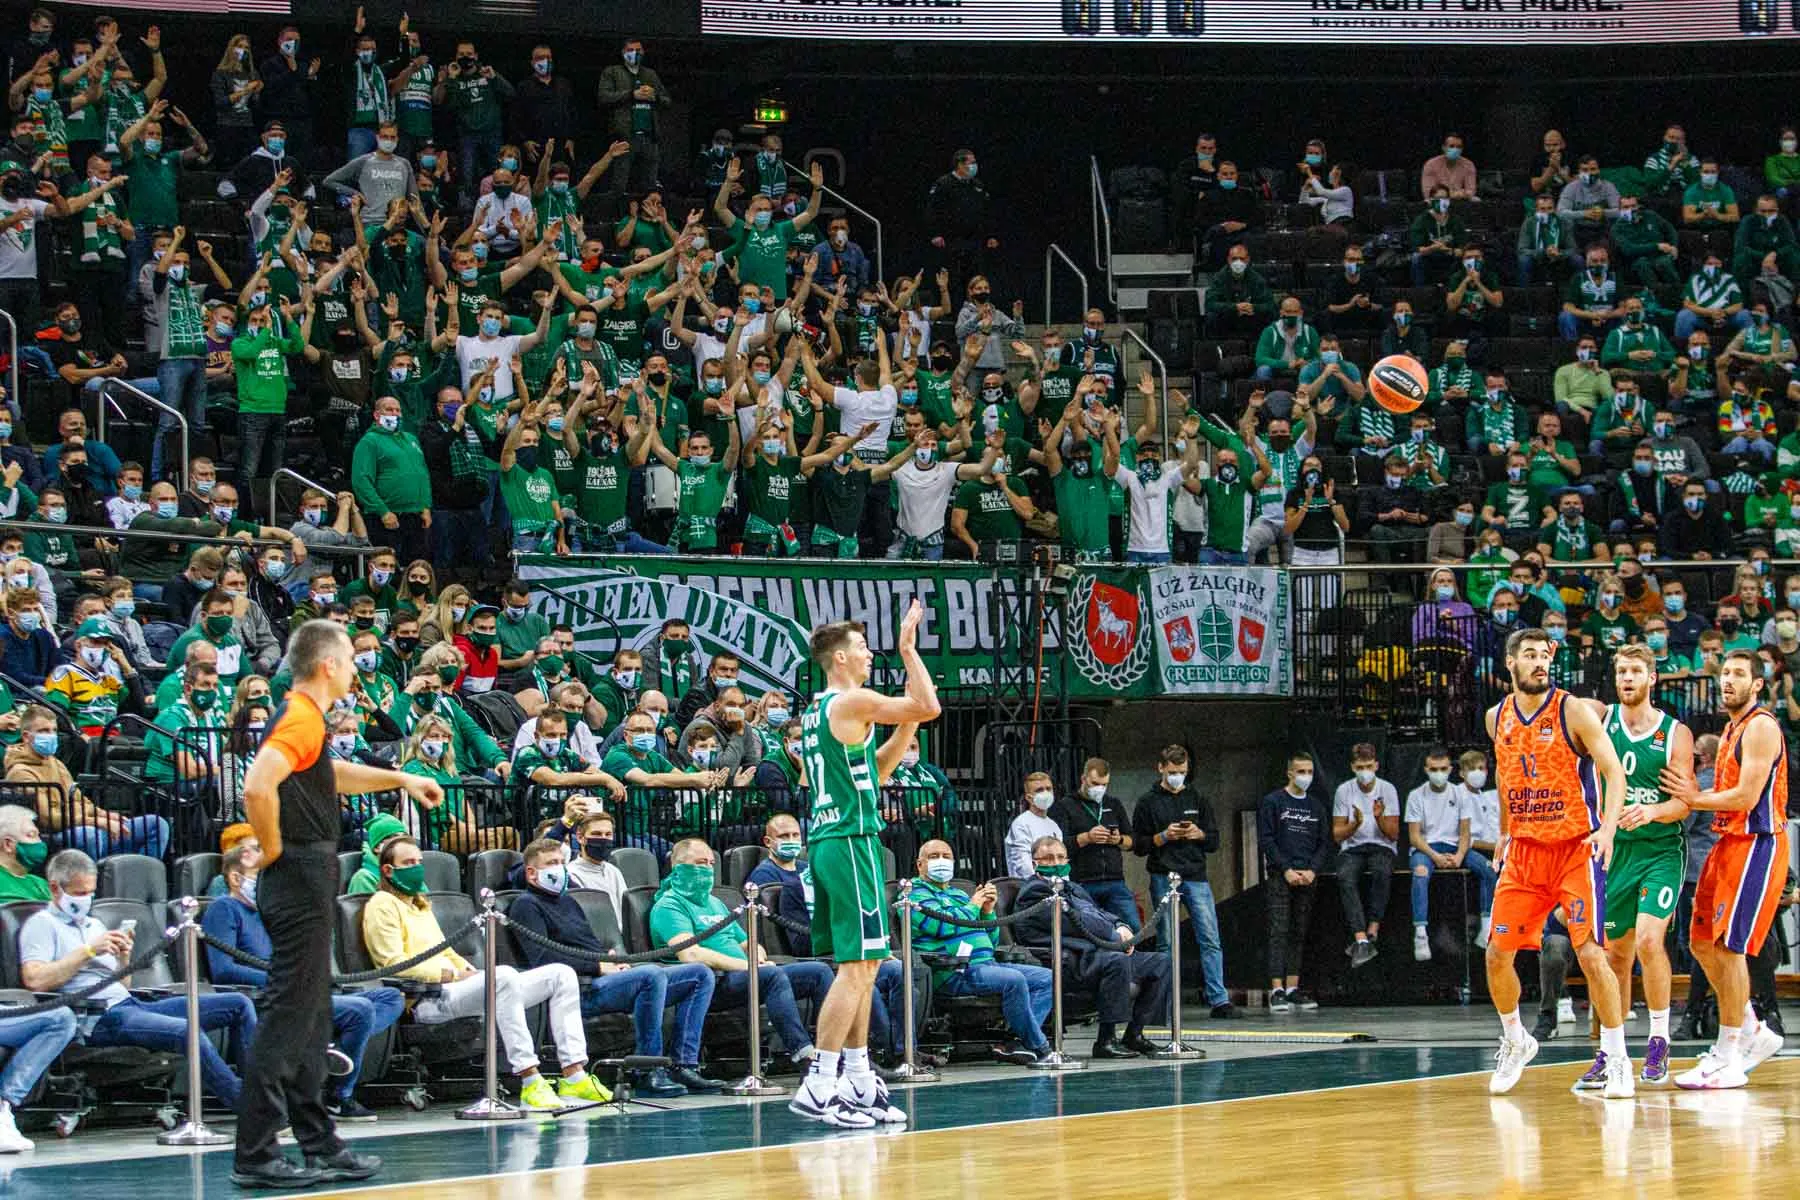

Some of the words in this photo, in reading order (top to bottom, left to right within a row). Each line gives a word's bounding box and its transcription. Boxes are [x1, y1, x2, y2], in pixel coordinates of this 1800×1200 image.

[1156, 576, 1184, 599] UŽ
[536, 580, 674, 629] GREEN
[803, 577, 940, 650] WHITE
[1156, 604, 1172, 620] UŽ
[1166, 666, 1216, 686] GREEN
[1520, 754, 1537, 778] 12
[1622, 751, 1636, 775] 0
[1508, 787, 1549, 801] Cultura
[1510, 800, 1564, 813] Esfuerzo
[1657, 886, 1673, 909] 0
